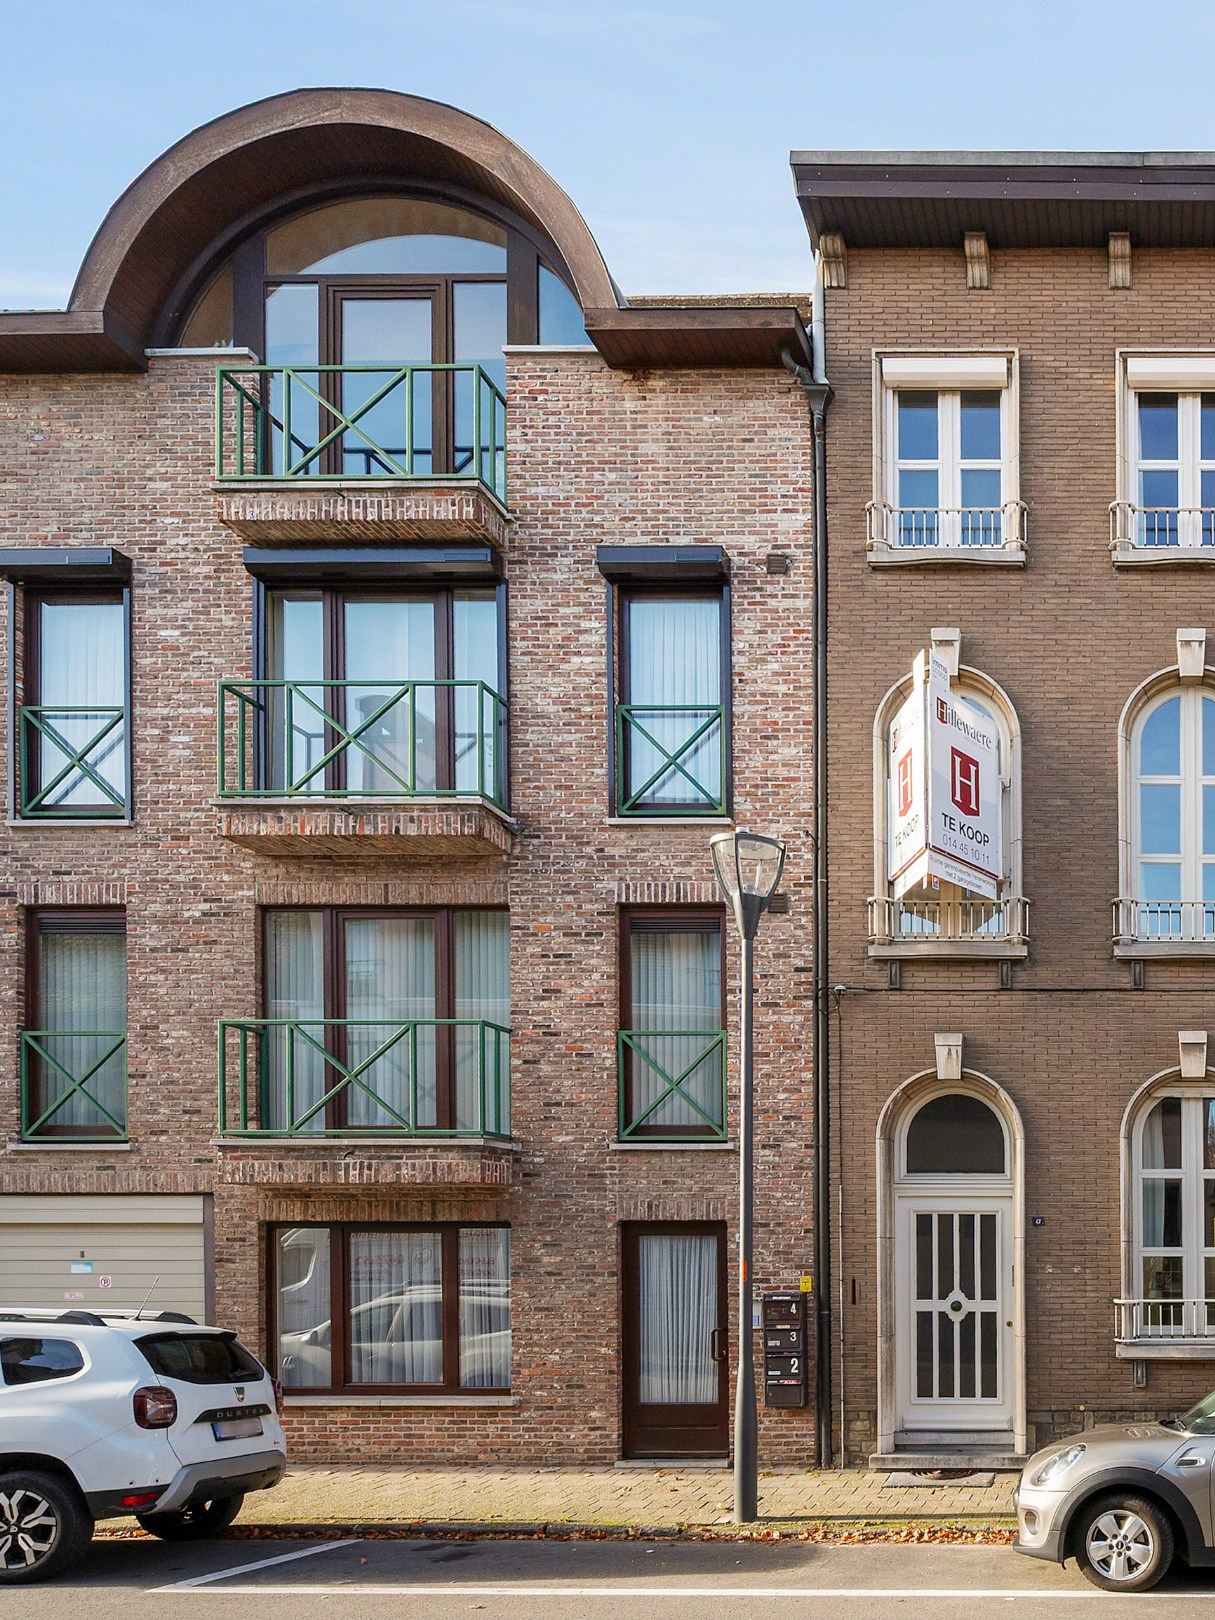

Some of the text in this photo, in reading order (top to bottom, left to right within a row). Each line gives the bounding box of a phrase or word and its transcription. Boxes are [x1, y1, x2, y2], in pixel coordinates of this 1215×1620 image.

[936, 696, 992, 749] Hillewaere
[953, 753, 978, 812] H
[941, 812, 990, 847] TE KOOP
[942, 834, 990, 865] 014 45 10 11
[790, 1302, 797, 1315] 4
[789, 1331, 797, 1342] 3
[790, 1357, 799, 1373] 2
[216, 1408, 265, 1419] DUSTER
